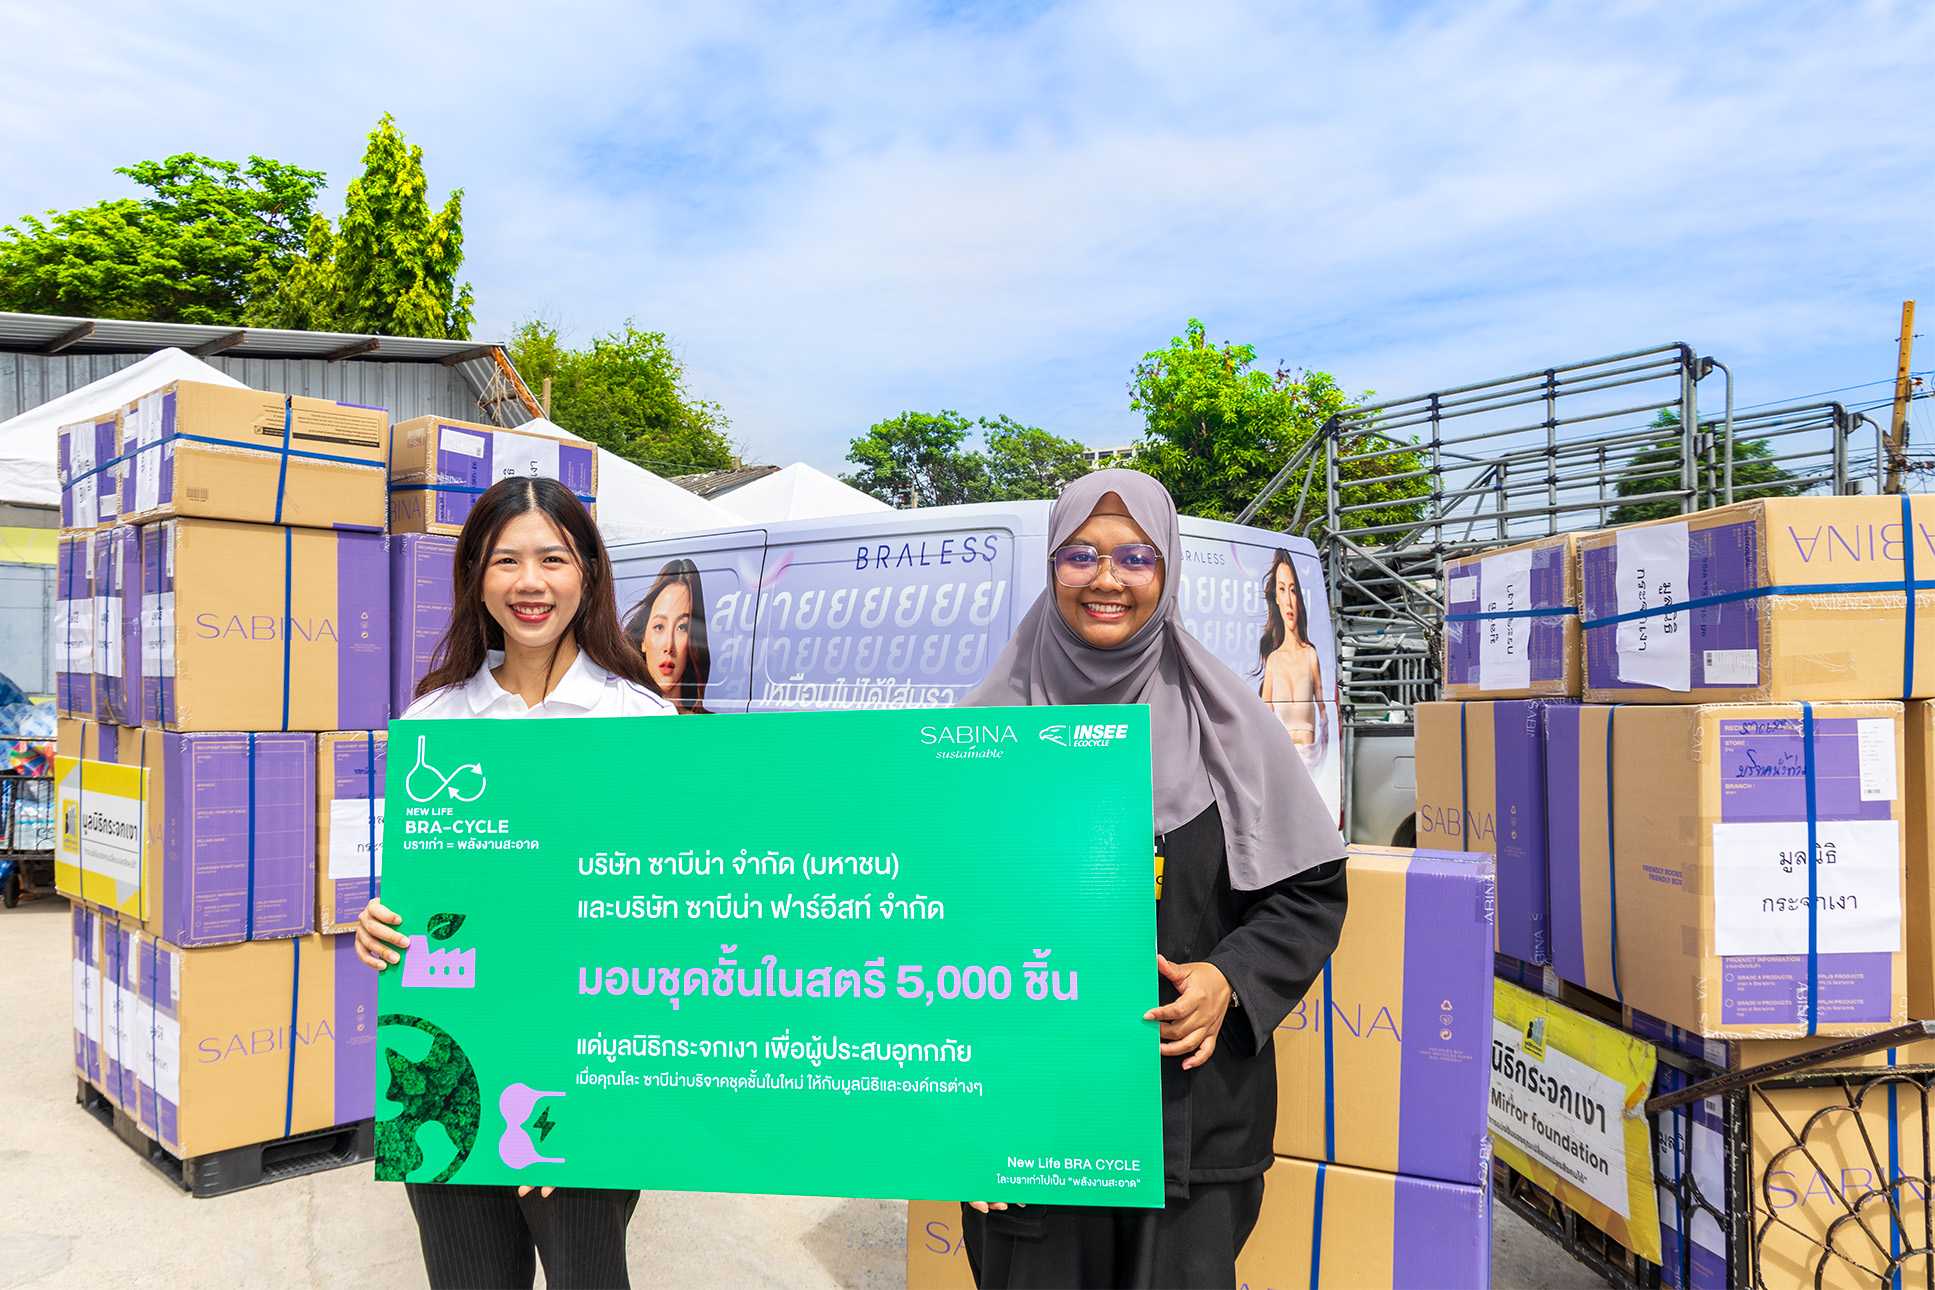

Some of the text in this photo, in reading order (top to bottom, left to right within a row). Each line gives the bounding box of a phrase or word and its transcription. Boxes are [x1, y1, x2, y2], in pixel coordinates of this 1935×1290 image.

[855, 534, 999, 571] BRALESS
[1787, 521, 1935, 563] BINA
[195, 612, 338, 643] SABINA
[920, 725, 1018, 745] SABINA
[1073, 724, 1129, 740] INSEE
[935, 745, 1004, 760] sustainable
[405, 819, 509, 834] BRA-CYCLE
[406, 807, 454, 816] NEW LIFE
[1421, 803, 1497, 842] SABNA
[403, 838, 444, 850] บราเก่า
[457, 838, 539, 850] พลังงานสะอาด
[1779, 842, 1838, 873] มูลนิธิ
[578, 848, 900, 881] บริษัท ซาบีน่า จำกัด (มหาชน)
[577, 891, 945, 920] และบริษัท ซาบีน่า ฟาร์อีสท์ จำกัด
[1762, 895, 1858, 912] กระจกเงา
[578, 943, 1079, 1011] มอบชุดชั้นในสตรี 5,000 ชิ้น
[1279, 999, 1401, 1041] BINA
[198, 1018, 336, 1064] SABINA
[576, 1029, 972, 1068] แด่มูลนิธิกระจกเงา เพื่อผู้ประสบอุทกภัย
[575, 1066, 983, 1097] เมื่อคุณโละ ซาบีน่าบริจาคชุดชั้นในใหม่ ให้กับมูลนิธิและองค์กรต่างๆ
[1491, 1040, 1607, 1135] นิธิกระจกเงา
[1491, 1086, 1529, 1125] Mirror
[1531, 1111, 1610, 1177] foundation
[1007, 1156, 1141, 1172] New Life BRA CYCLE
